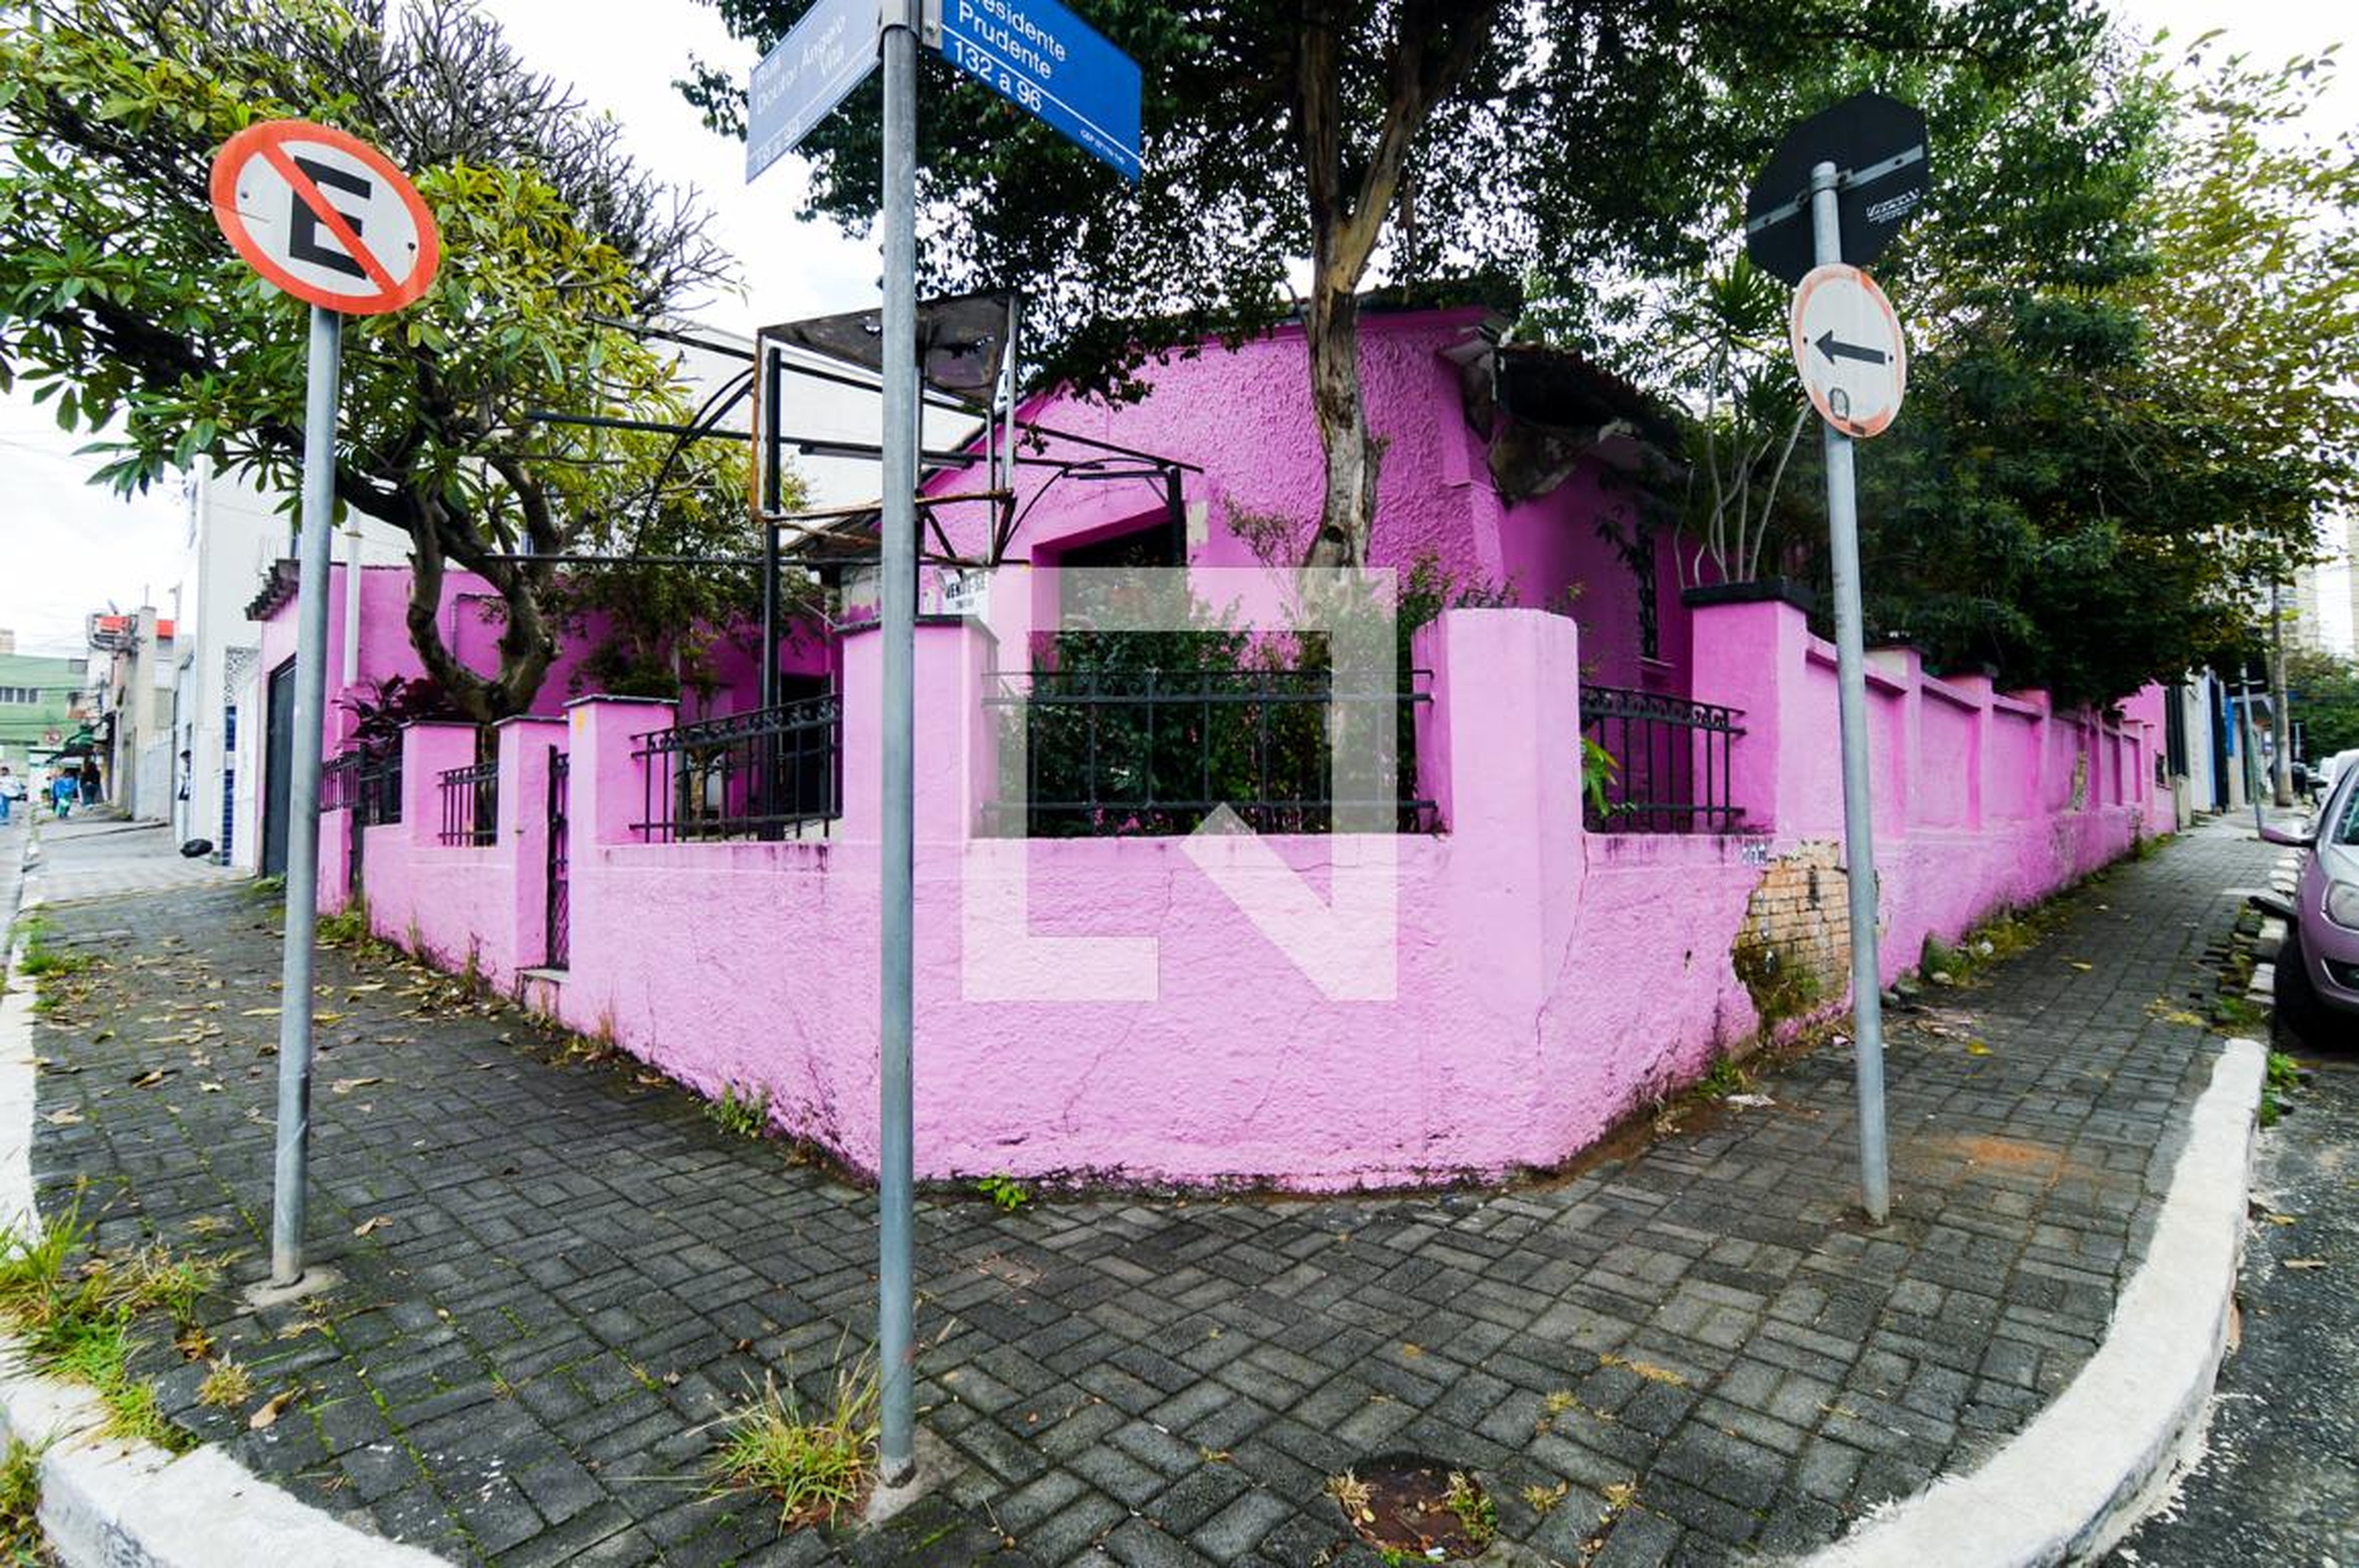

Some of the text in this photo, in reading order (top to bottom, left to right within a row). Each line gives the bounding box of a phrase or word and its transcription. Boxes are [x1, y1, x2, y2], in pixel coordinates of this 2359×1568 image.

[955, 41, 1041, 112] 132 a 96
[959, 1, 1052, 79] Prudente
[289, 155, 372, 281] E
